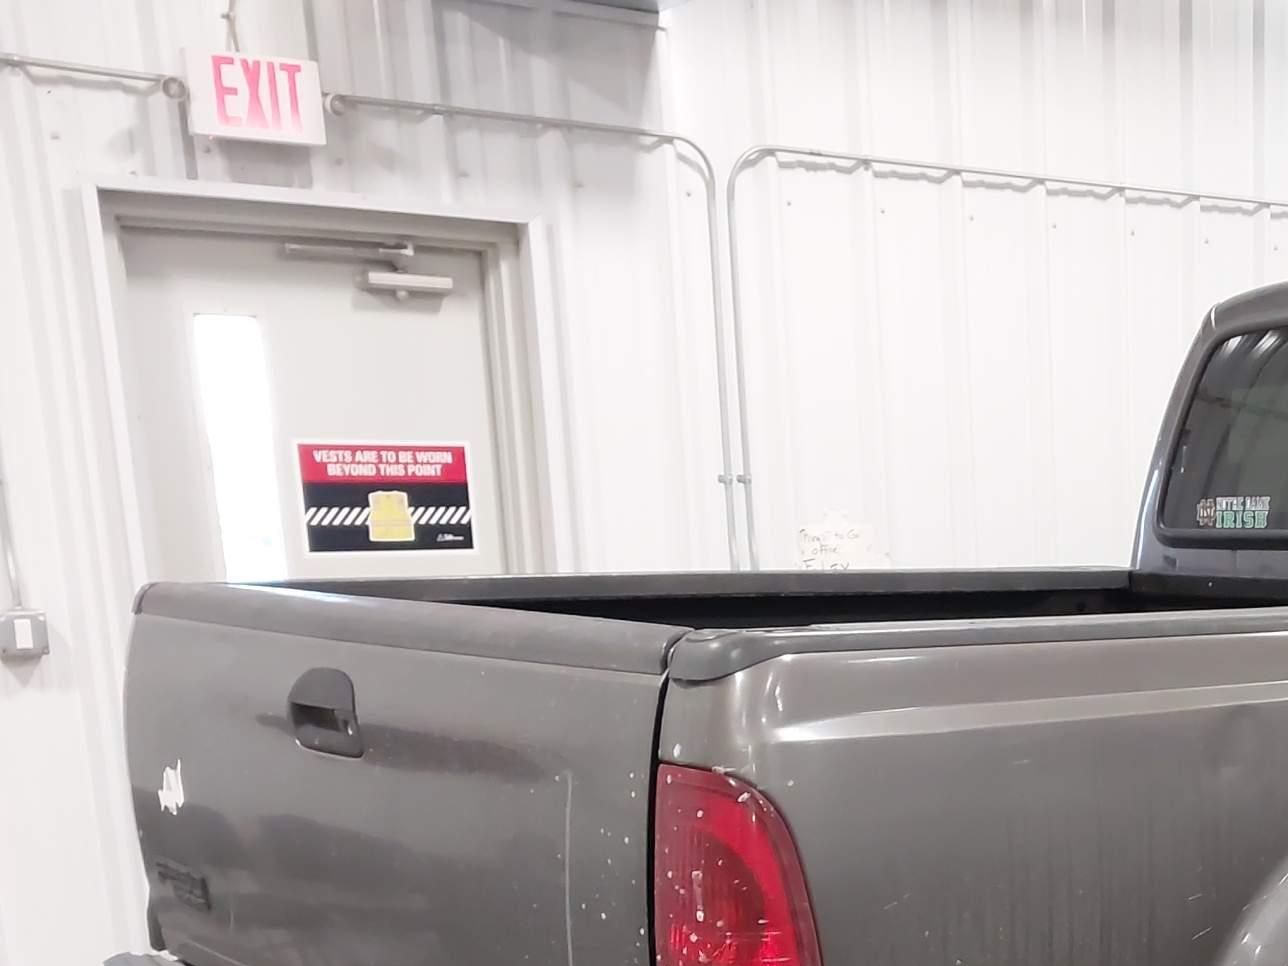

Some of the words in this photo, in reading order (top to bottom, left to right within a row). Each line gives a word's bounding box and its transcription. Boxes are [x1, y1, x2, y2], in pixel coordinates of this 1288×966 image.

[211, 55, 304, 131] EXIT
[313, 450, 352, 463] VESTS
[355, 451, 379, 463] ARE
[380, 451, 396, 463] TO
[399, 451, 414, 463] BE
[415, 451, 453, 464] WORN
[327, 464, 376, 476] BEYOND
[377, 464, 405, 476] THIS
[407, 464, 442, 476] POINT
[1215, 510, 1268, 529] IRISH
